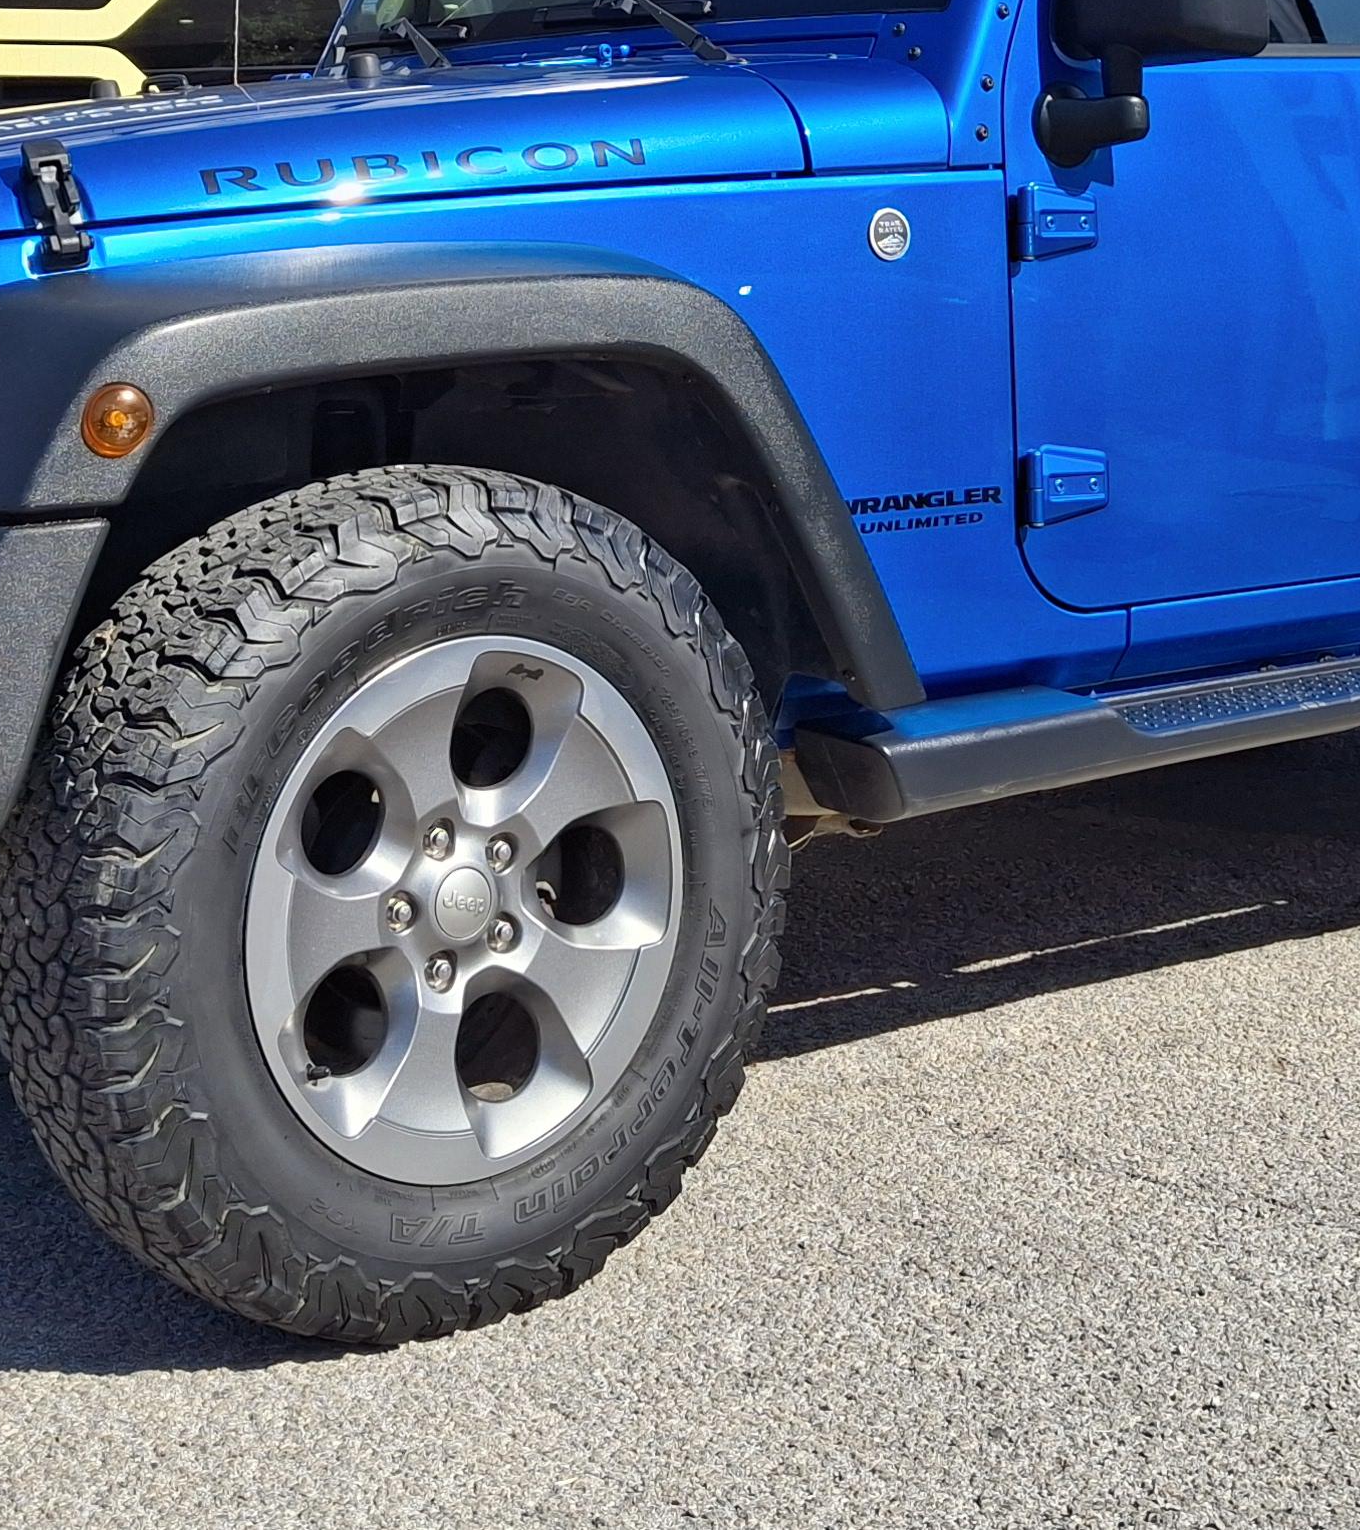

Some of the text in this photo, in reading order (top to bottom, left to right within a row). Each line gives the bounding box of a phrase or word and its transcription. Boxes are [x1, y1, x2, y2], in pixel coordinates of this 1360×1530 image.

[198, 138, 647, 195] RUBICON
[859, 511, 984, 535] UNLIMITED
[443, 890, 485, 917] Jeep
